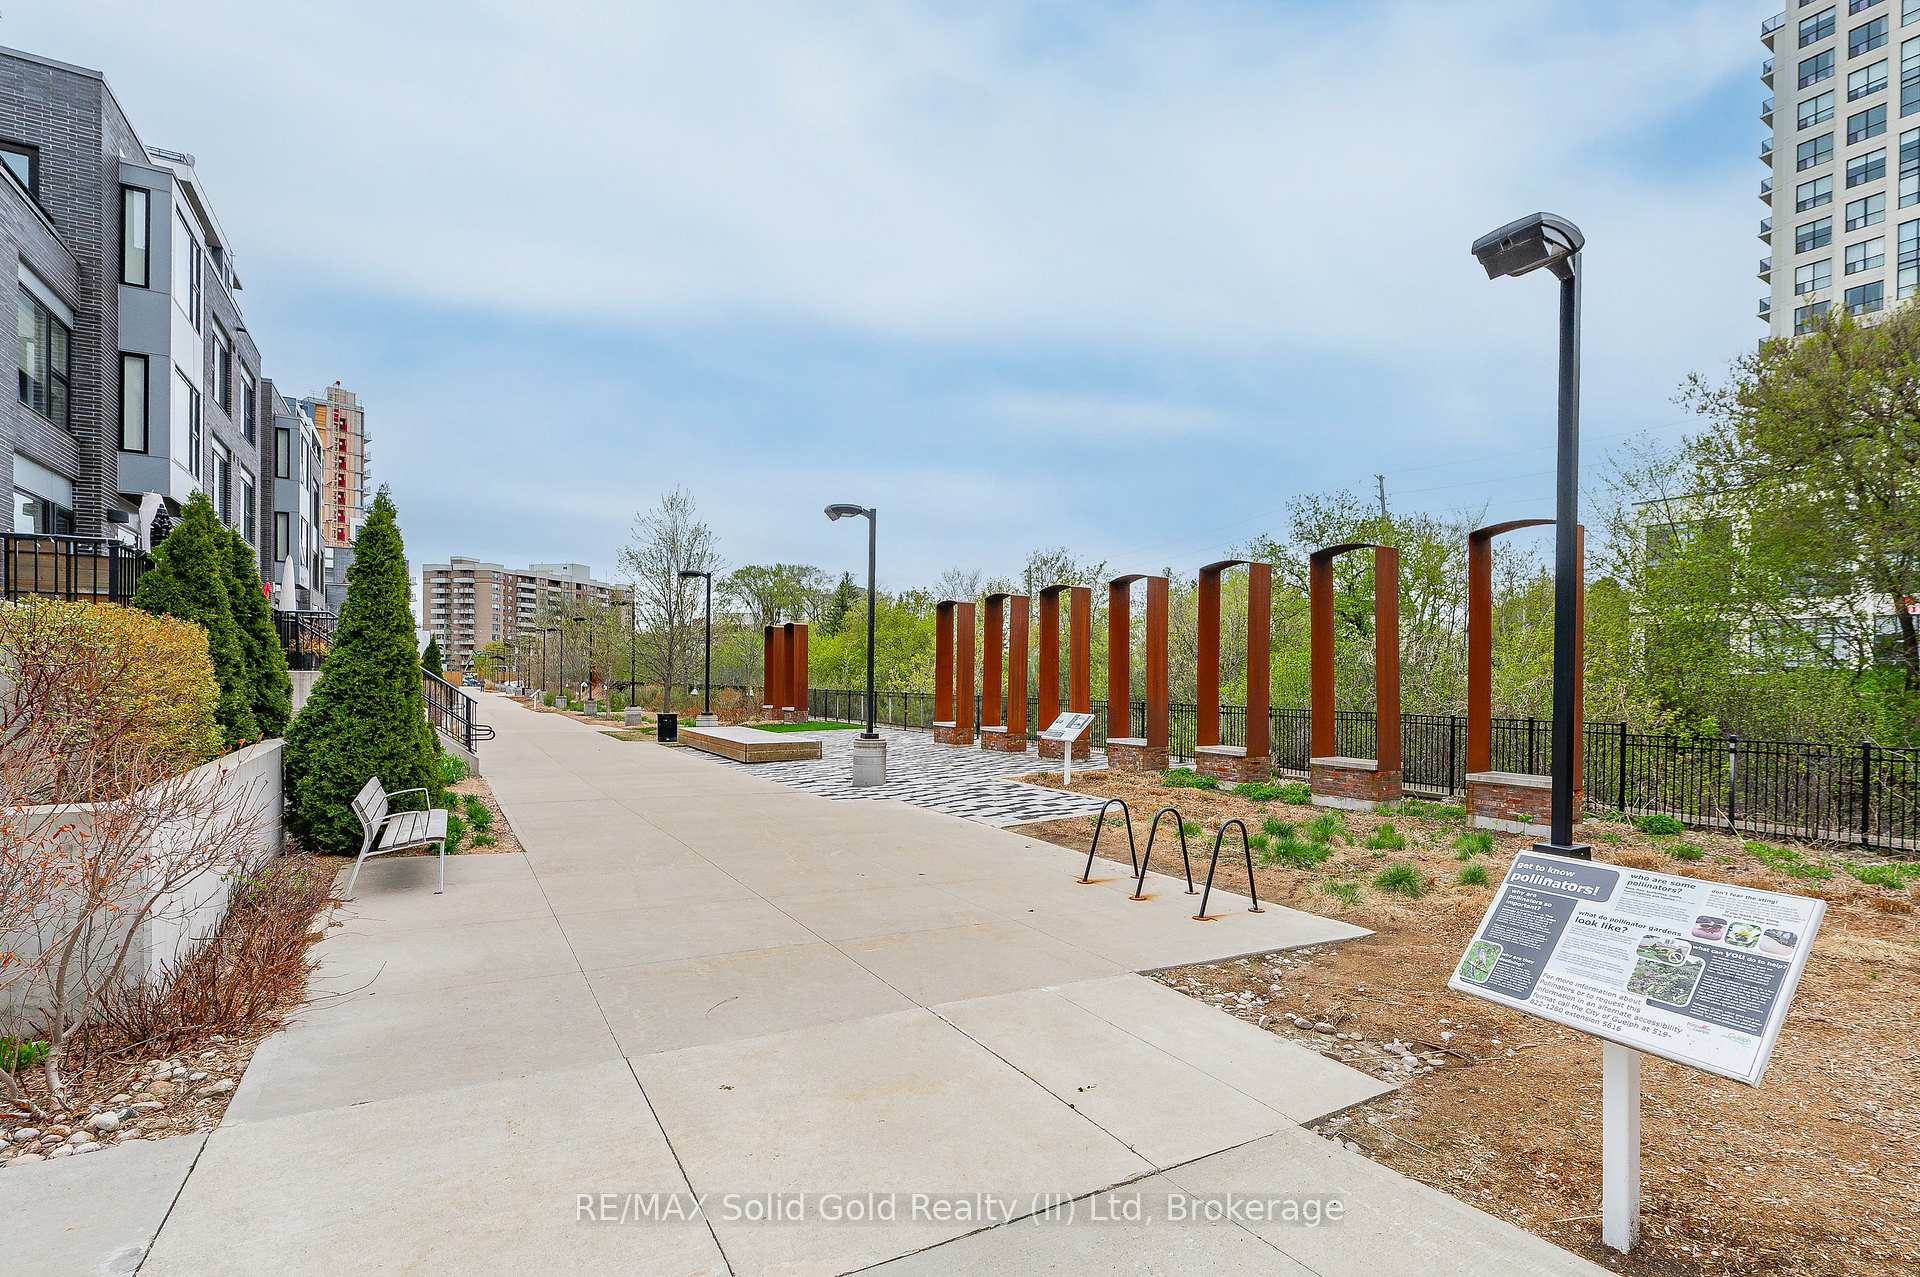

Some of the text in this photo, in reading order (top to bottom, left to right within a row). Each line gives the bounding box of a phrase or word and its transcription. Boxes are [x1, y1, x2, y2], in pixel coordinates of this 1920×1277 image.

[1516, 862, 1576, 877] get to know
[1510, 872, 1601, 896] pollinators!
[1626, 880, 1683, 894] pollinators?
[1652, 877, 1667, 885] are
[1670, 880, 1696, 890] some
[1574, 916, 1628, 934] look like?
[1578, 911, 1597, 919] what
[1609, 917, 1648, 929] pollinator
[1648, 926, 1682, 937] gardens
[1692, 945, 1710, 953] what
[1725, 951, 1746, 960] you
[1767, 961, 1788, 970] help?
[1539, 979, 1576, 994] Pollinators
[1596, 996, 1625, 1009] request
[1626, 1004, 1641, 1013] this
[1555, 976, 1574, 985] more
[1575, 983, 1617, 998] information
[1619, 994, 1642, 1005] about
[1532, 992, 1556, 1003] format
[1557, 1000, 1570, 1008] call
[1571, 1004, 1584, 1012] the
[1585, 1008, 1600, 1017] City
[1611, 1016, 1640, 1029] Guelph
[1536, 986, 1576, 1002] information
[1598, 1005, 1632, 1018] alternate
[1633, 1015, 1683, 1034] accessibility
[1564, 1010, 1600, 1025] extension
